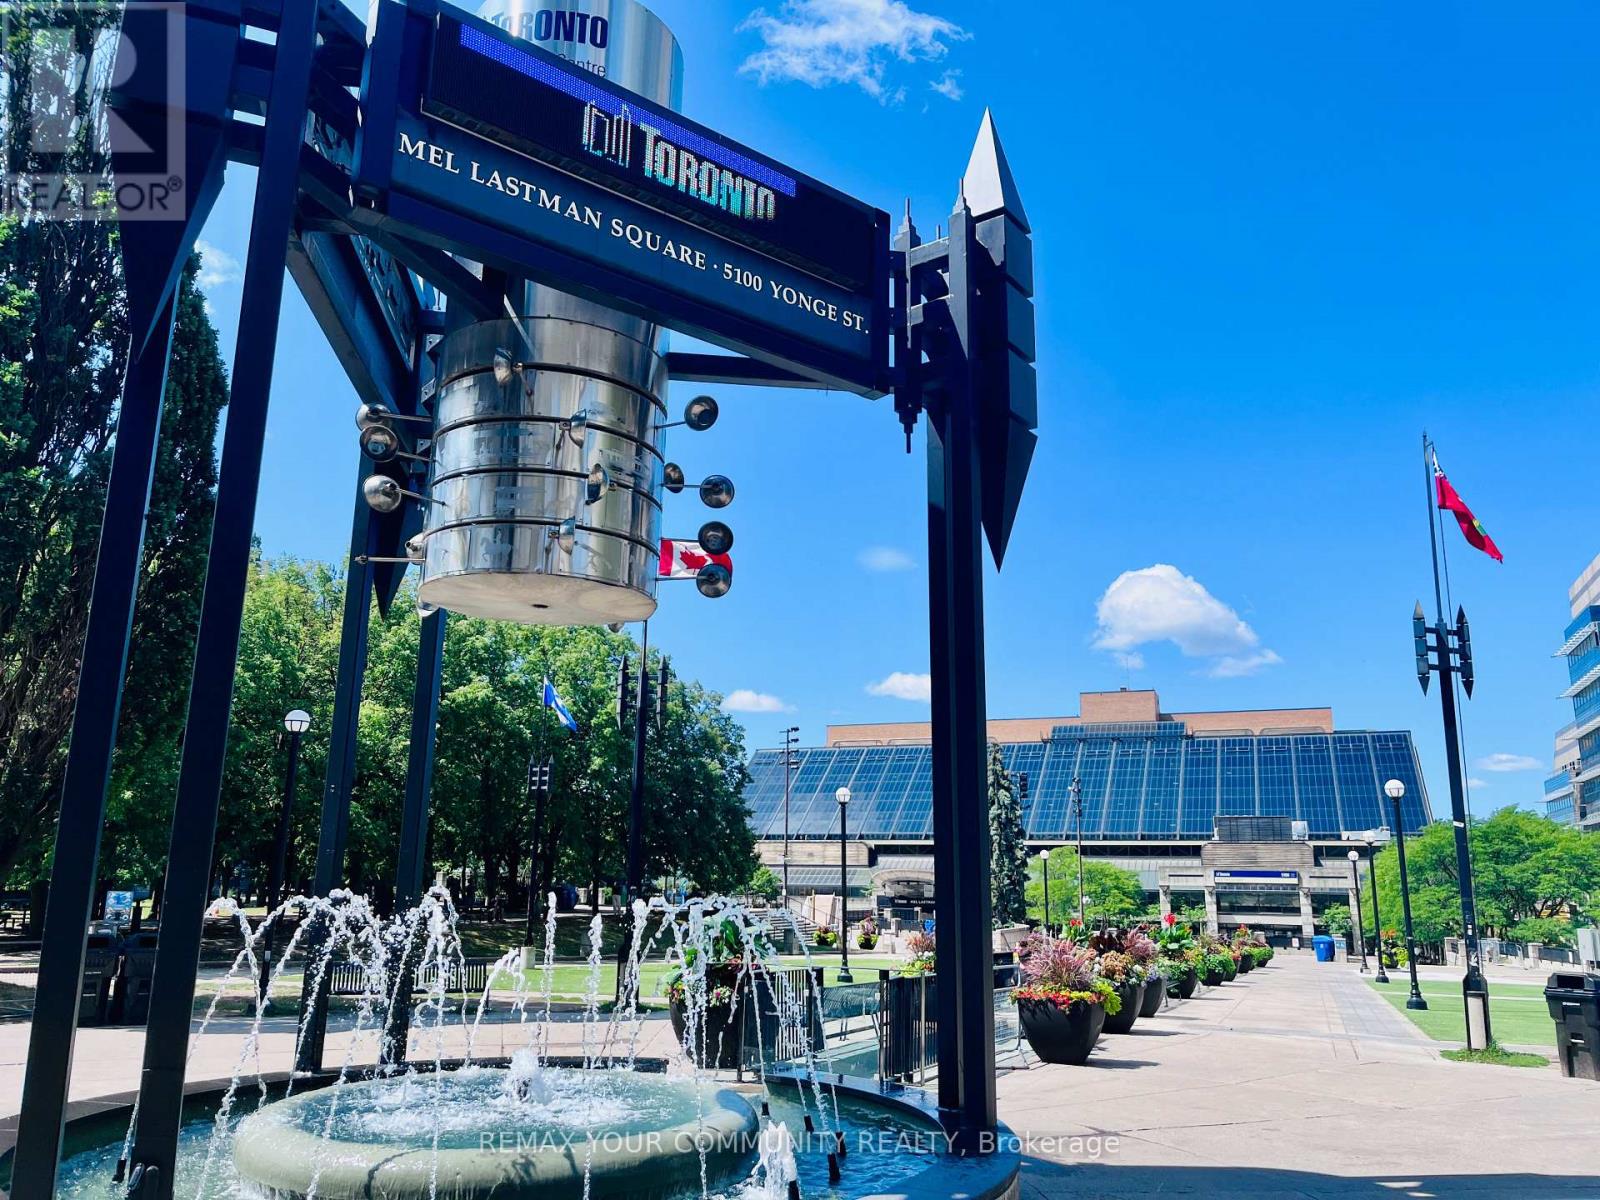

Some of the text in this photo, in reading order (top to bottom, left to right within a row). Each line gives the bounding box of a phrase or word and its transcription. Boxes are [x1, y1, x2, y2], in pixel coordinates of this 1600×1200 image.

[398, 132, 460, 175] MEL
[470, 160, 602, 230] LASTMAN
[611, 218, 706, 271] SQUARE
[723, 262, 763, 292] 5100
[770, 280, 838, 322] YONGE
[843, 310, 870, 334] ST.
[639, 122, 776, 220] TORONTO
